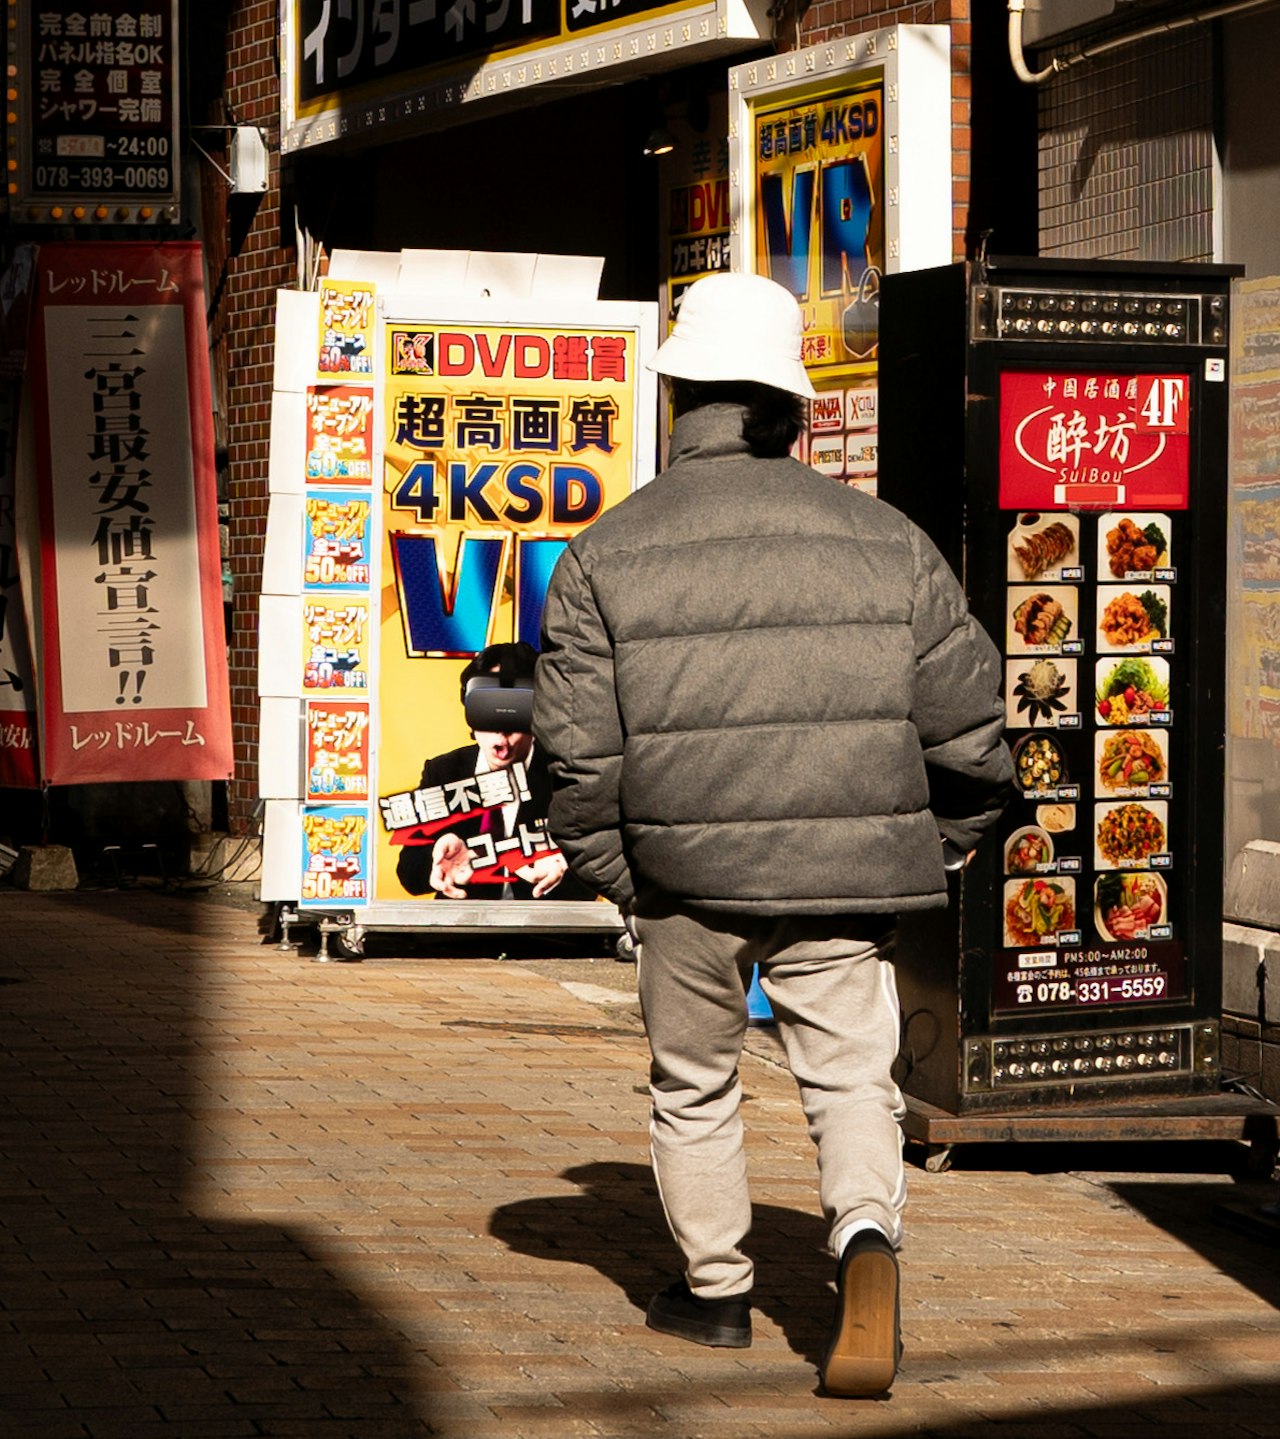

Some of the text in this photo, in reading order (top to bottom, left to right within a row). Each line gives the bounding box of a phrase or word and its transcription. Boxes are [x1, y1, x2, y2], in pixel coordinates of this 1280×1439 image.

[39, 12, 164, 38] 完全前金制
[38, 42, 164, 66] パネル指名OK
[40, 69, 163, 95] 完全個室
[40, 98, 163, 123] シャワー完備
[820, 99, 879, 146] 4KSD
[36, 166, 169, 189] 078-393-0069
[760, 152, 876, 304] VR
[46, 269, 181, 296] レッドルーム
[321, 288, 374, 310] リニューアル
[323, 330, 367, 348] 全コース
[439, 333, 626, 382] DVD鑑賞
[307, 394, 373, 415] リニューアル
[1140, 378, 1184, 427] 4F
[395, 395, 617, 453] 超高画質
[314, 434, 366, 453] 全コース
[395, 462, 602, 524] 4KSD
[83, 314, 162, 706] 三宮最安値宣言!!
[306, 500, 370, 519] リニューアル
[313, 539, 363, 557] 全コース
[304, 606, 369, 625] リニューアル
[310, 645, 361, 663] 全コース
[309, 710, 369, 729] リニューアル
[70, 720, 206, 751] レッドルーム
[314, 750, 362, 769] 全コース
[379, 762, 532, 833] 通信不要!
[304, 816, 367, 835] リニューアル
[309, 854, 361, 872] 全コース
[1037, 976, 1165, 1003] 078-331-5559
